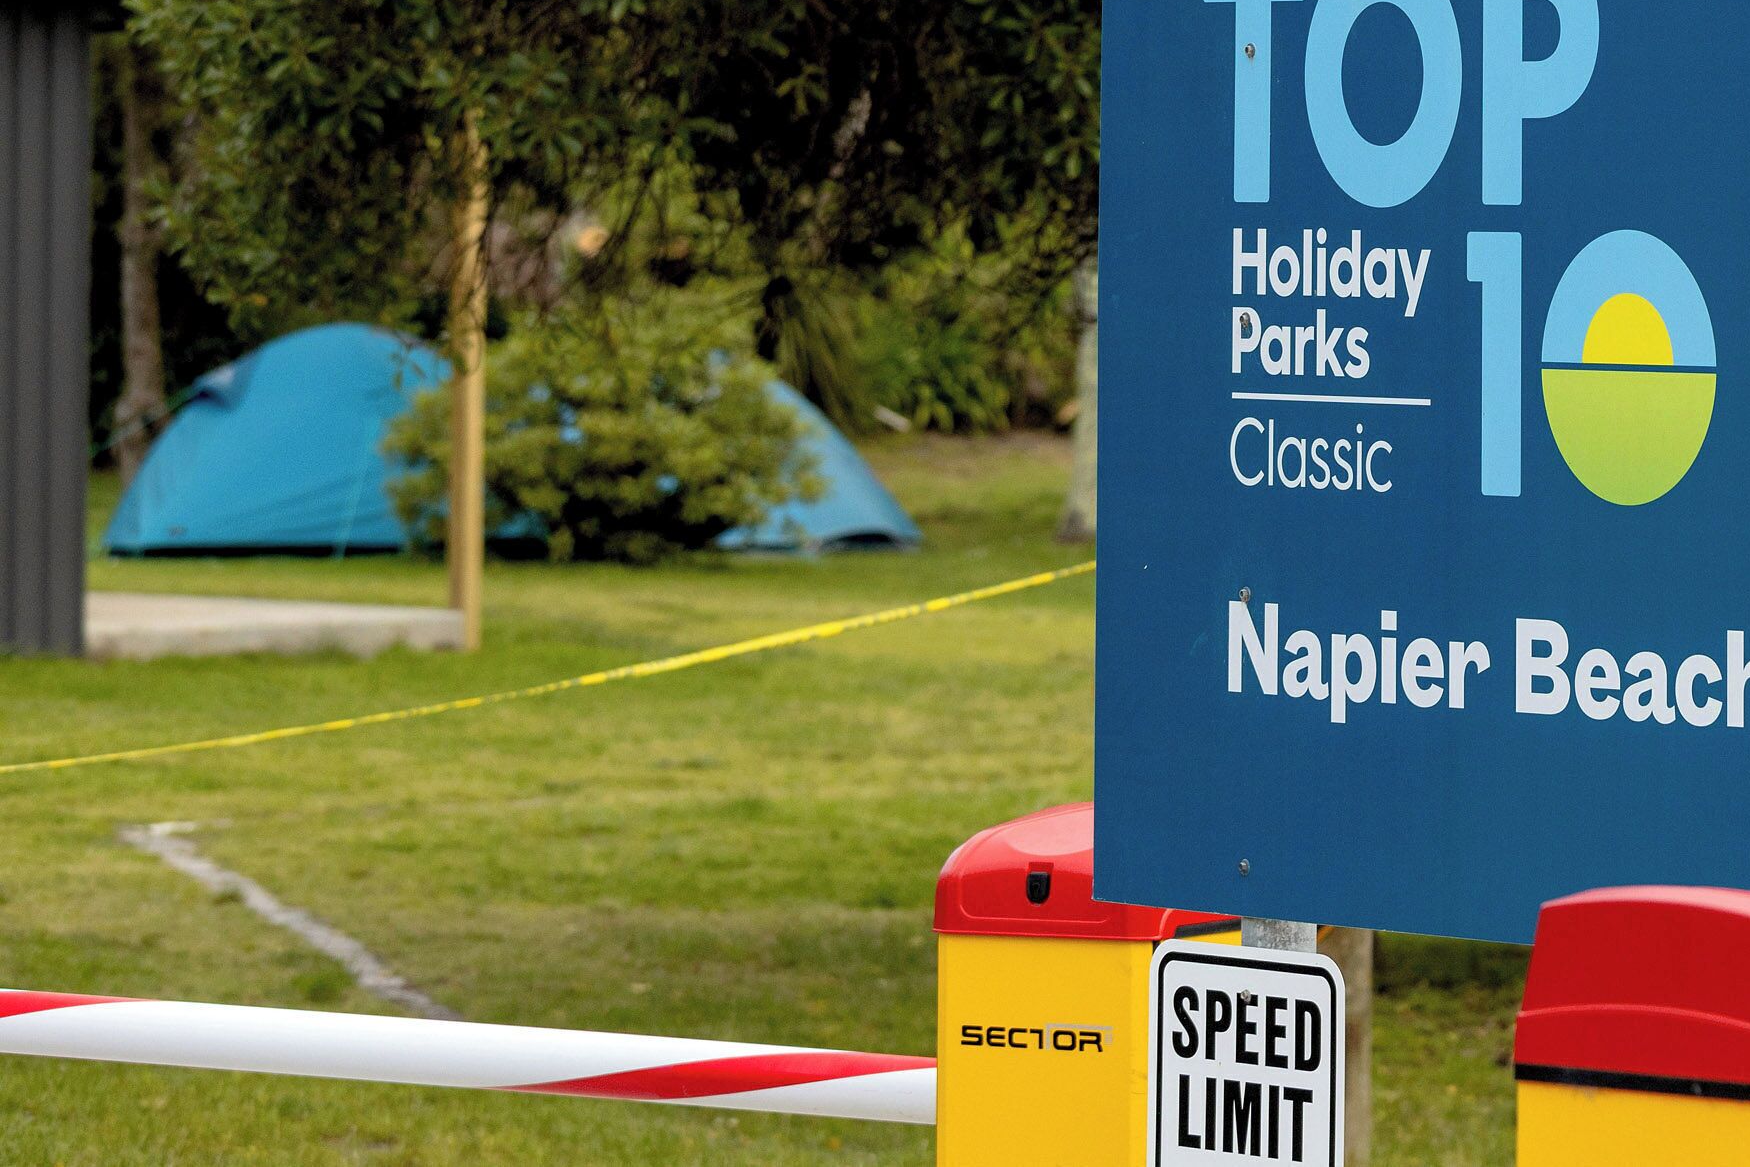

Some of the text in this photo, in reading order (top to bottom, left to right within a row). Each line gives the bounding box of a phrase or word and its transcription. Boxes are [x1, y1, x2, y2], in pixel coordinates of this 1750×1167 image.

[1232, 228, 1431, 316] Holiday
[1232, 308, 1370, 378] Parks
[1467, 229, 1717, 506] 10
[1230, 417, 1392, 492] Classic
[1228, 601, 1490, 723] Napier
[961, 1025, 1103, 1052] SECTOR
[1172, 986, 1322, 1072] SPEED
[1178, 1074, 1313, 1162] LIMIT
